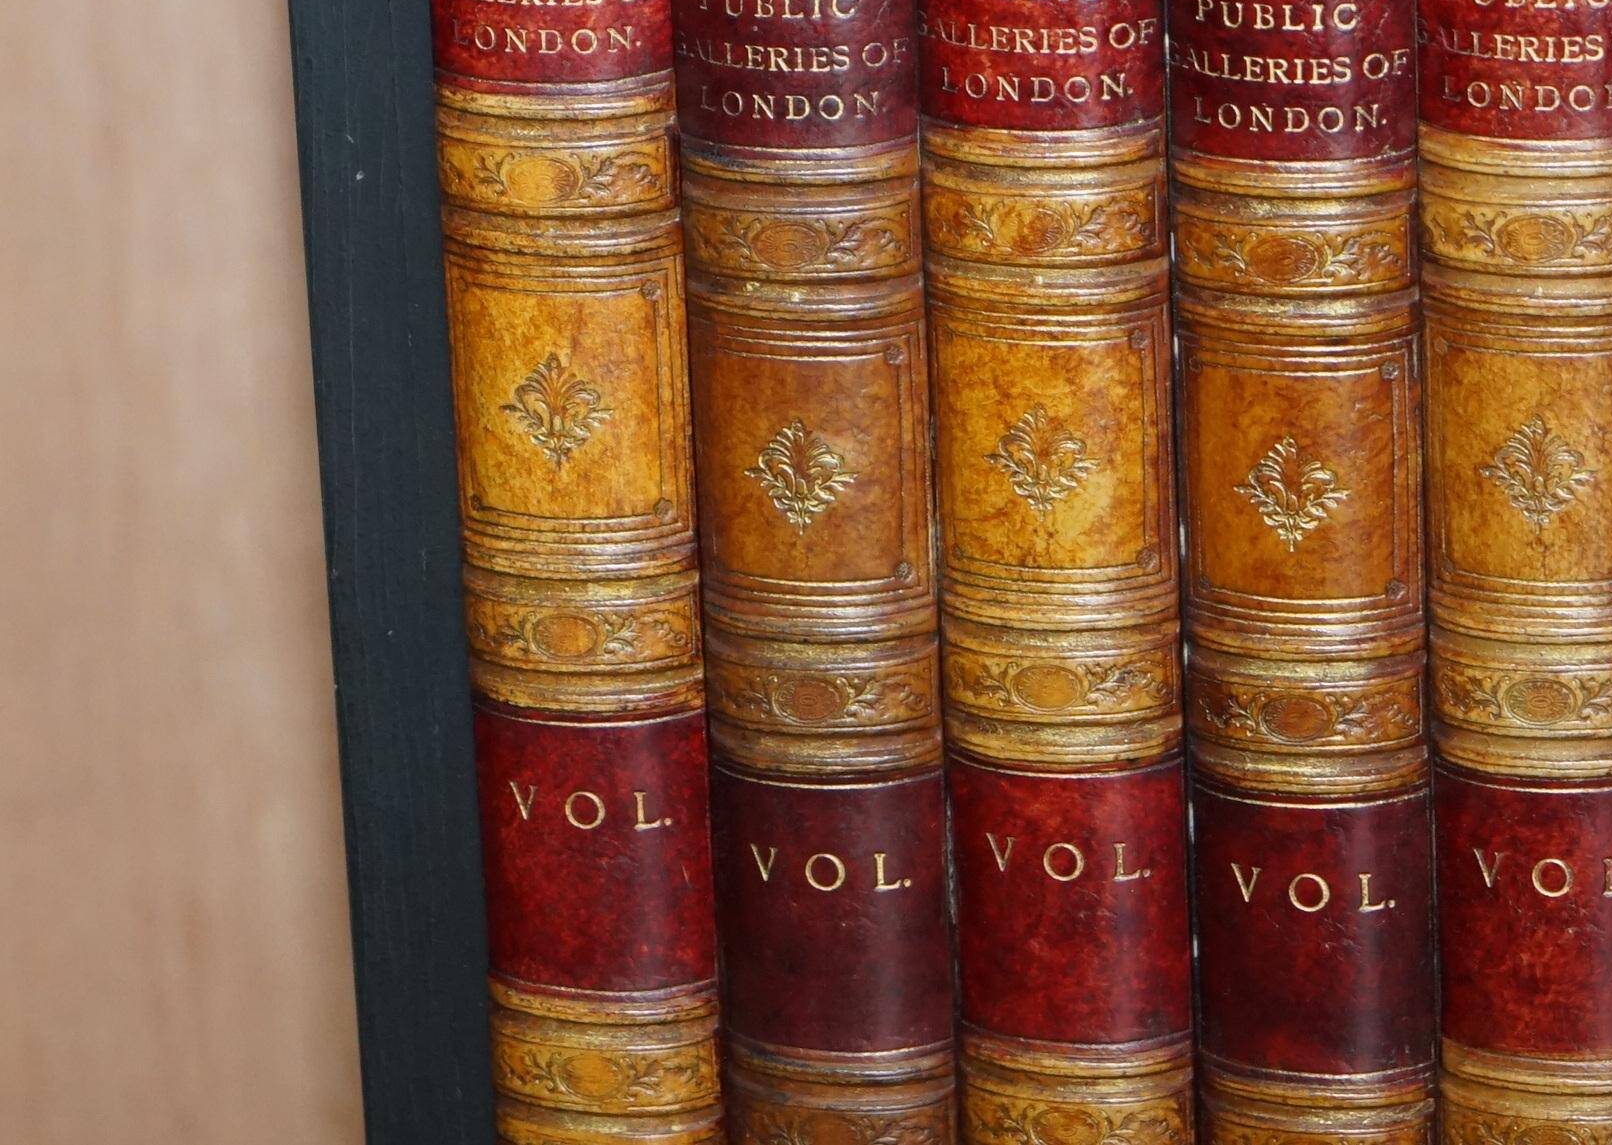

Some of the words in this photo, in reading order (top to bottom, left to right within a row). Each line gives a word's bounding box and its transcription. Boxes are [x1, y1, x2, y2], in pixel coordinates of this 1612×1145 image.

[453, 19, 641, 55] LONDON.
[1109, 18, 1157, 49] OF
[862, 38, 909, 67] OF
[1363, 49, 1410, 79] OF
[941, 67, 1134, 102] LONDON.
[1194, 97, 1387, 133] LONDON.
[509, 781, 672, 831] VOL.
[750, 843, 911, 891] VOL.
[985, 832, 1151, 881] VOL.
[1231, 863, 1396, 913] VOL.
